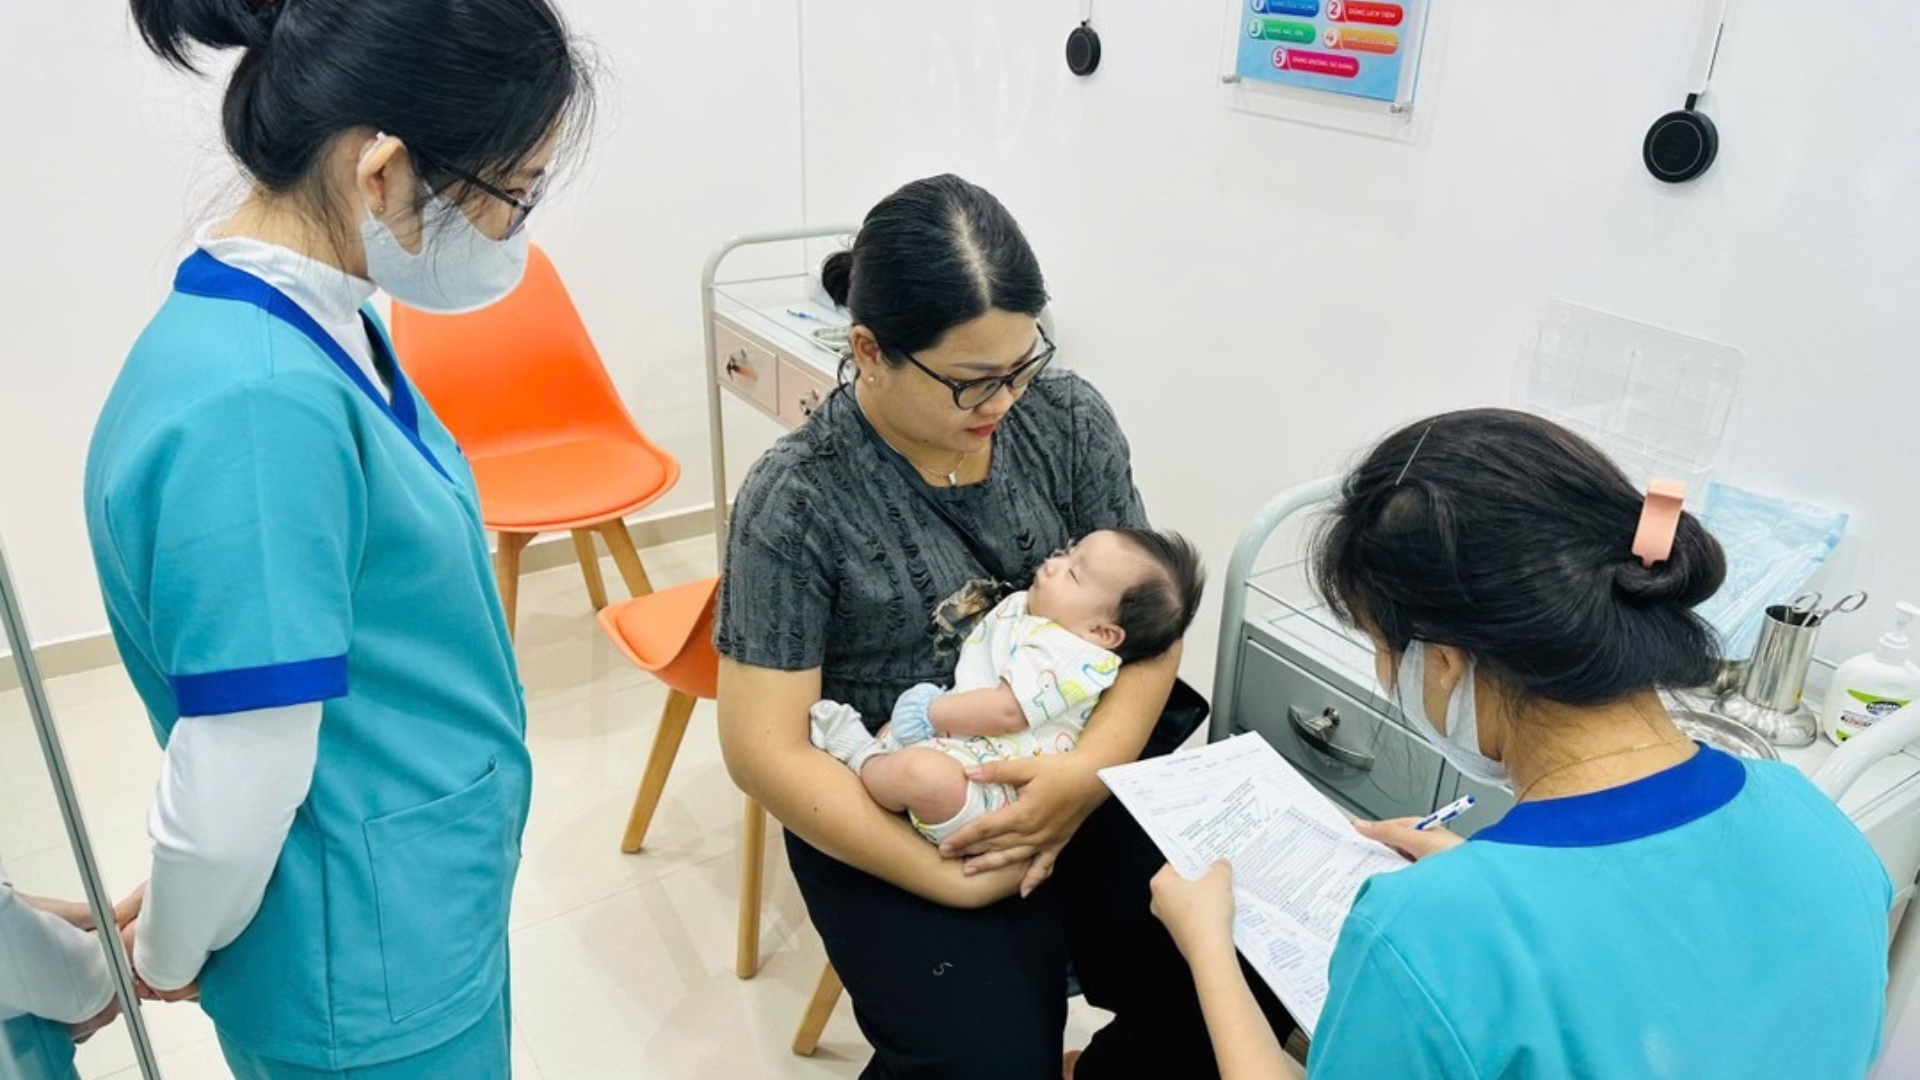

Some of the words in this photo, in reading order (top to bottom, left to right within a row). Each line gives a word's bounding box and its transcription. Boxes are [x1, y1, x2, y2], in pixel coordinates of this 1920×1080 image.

[1330, 1, 1338, 15] 2
[1251, 21, 1259, 34] 3
[1276, 50, 1282, 63] 5
